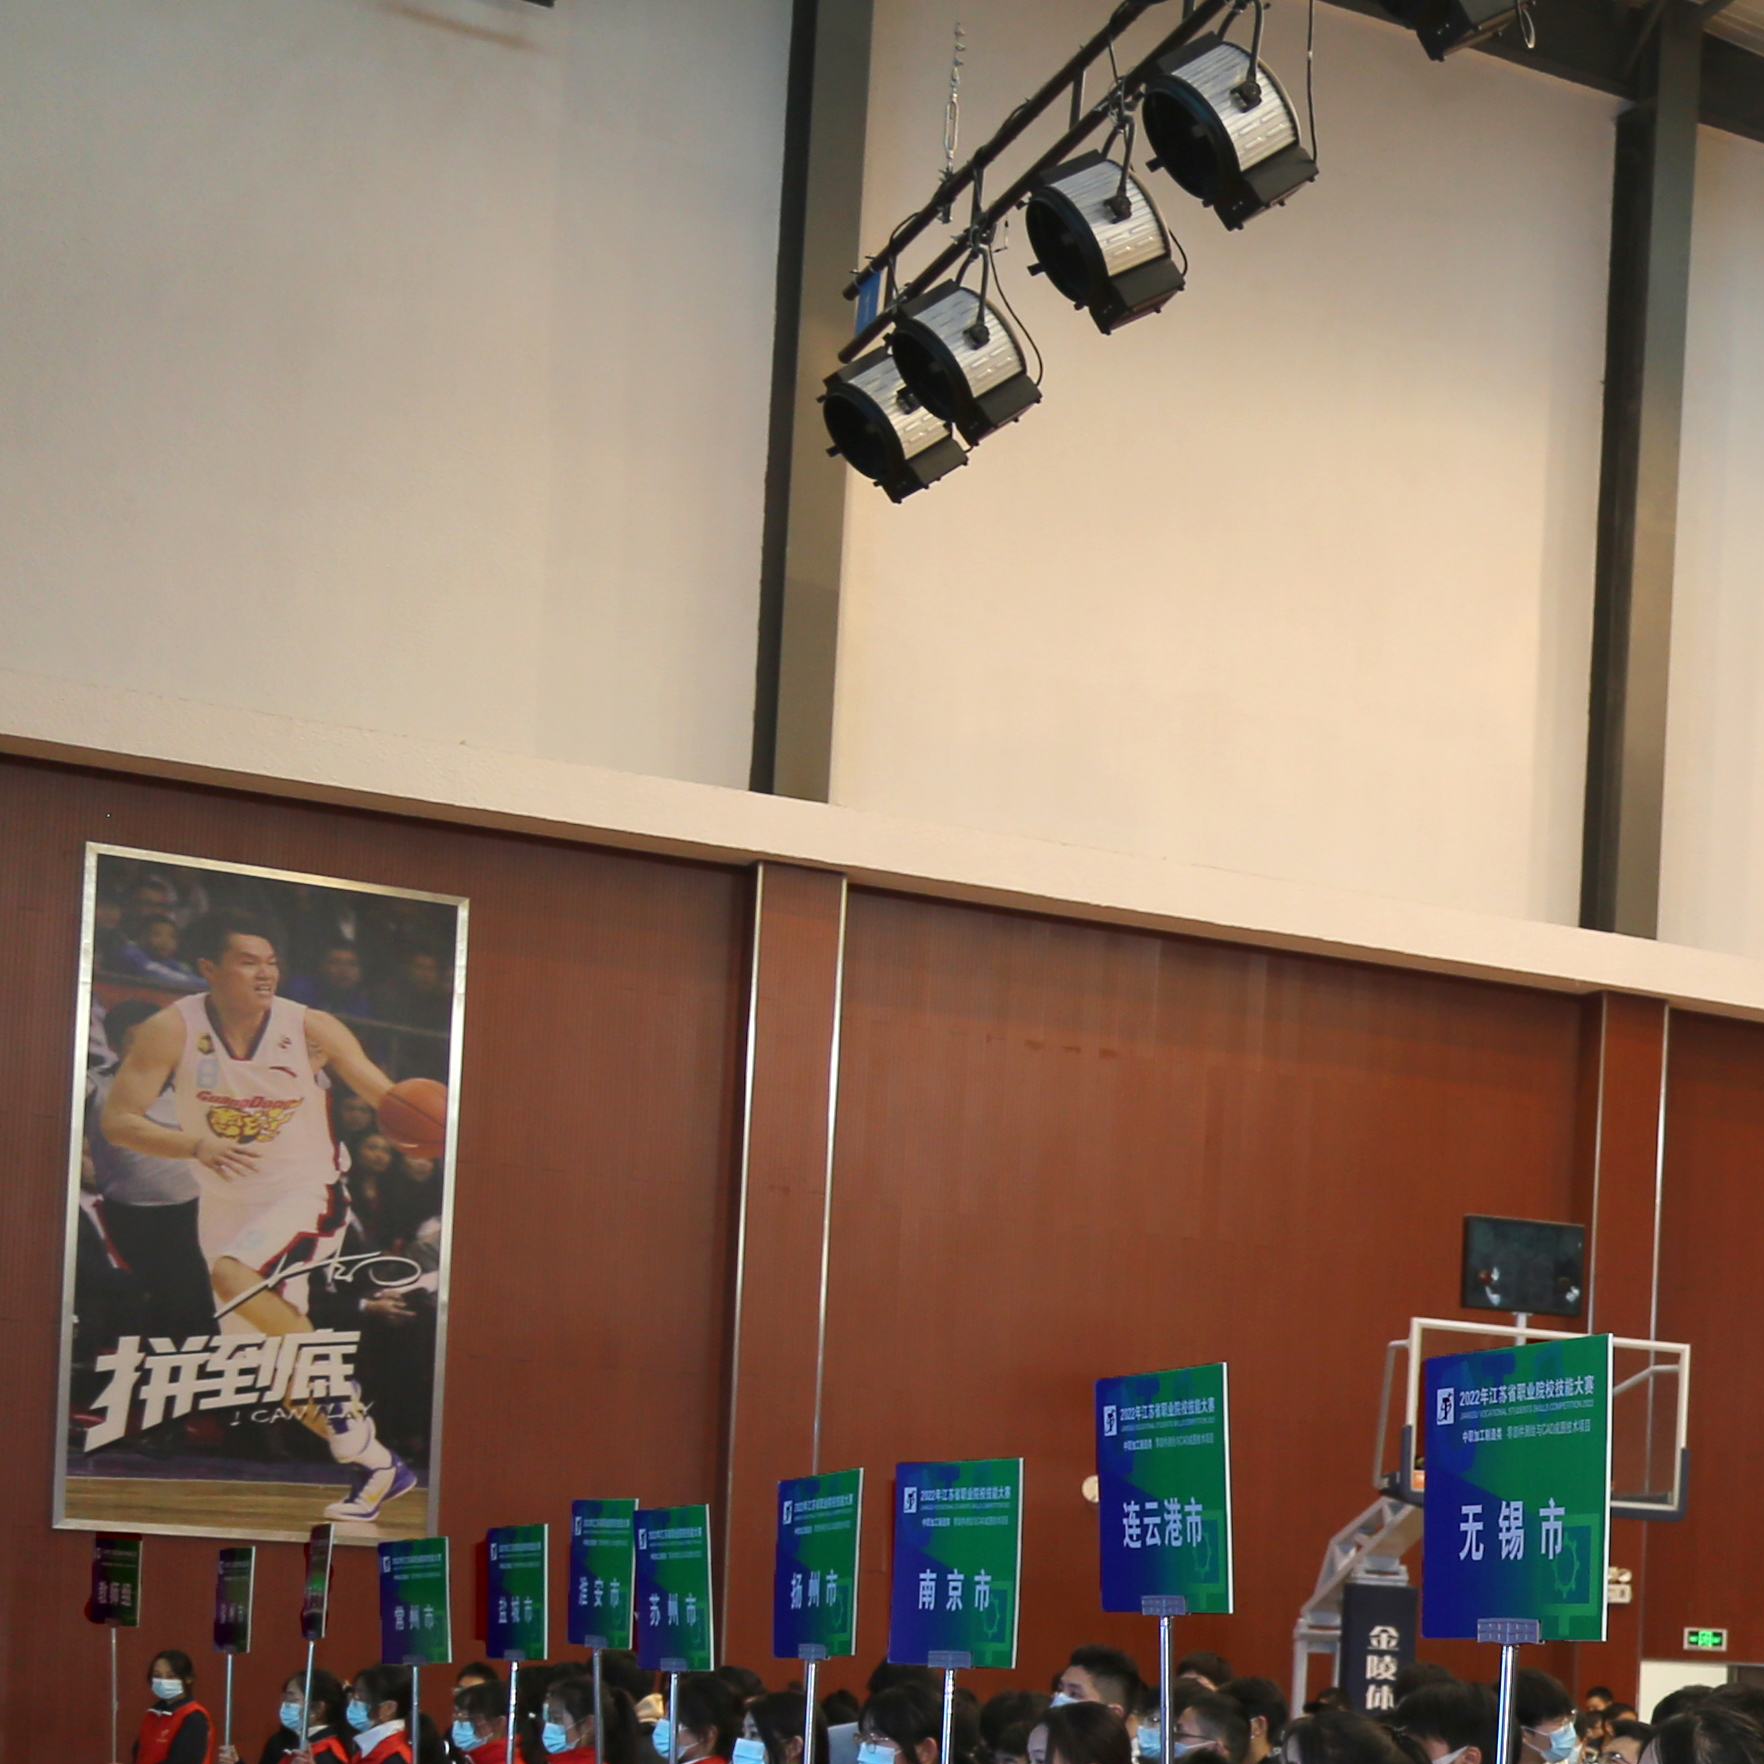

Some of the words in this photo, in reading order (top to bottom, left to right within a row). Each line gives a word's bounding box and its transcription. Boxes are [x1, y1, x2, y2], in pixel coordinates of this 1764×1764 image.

[84, 1327, 361, 1455] 拼到底
[1122, 1497, 1203, 1549] 连云港市
[1458, 1497, 1566, 1561] 无锡市
[918, 1568, 992, 1611] 南京市
